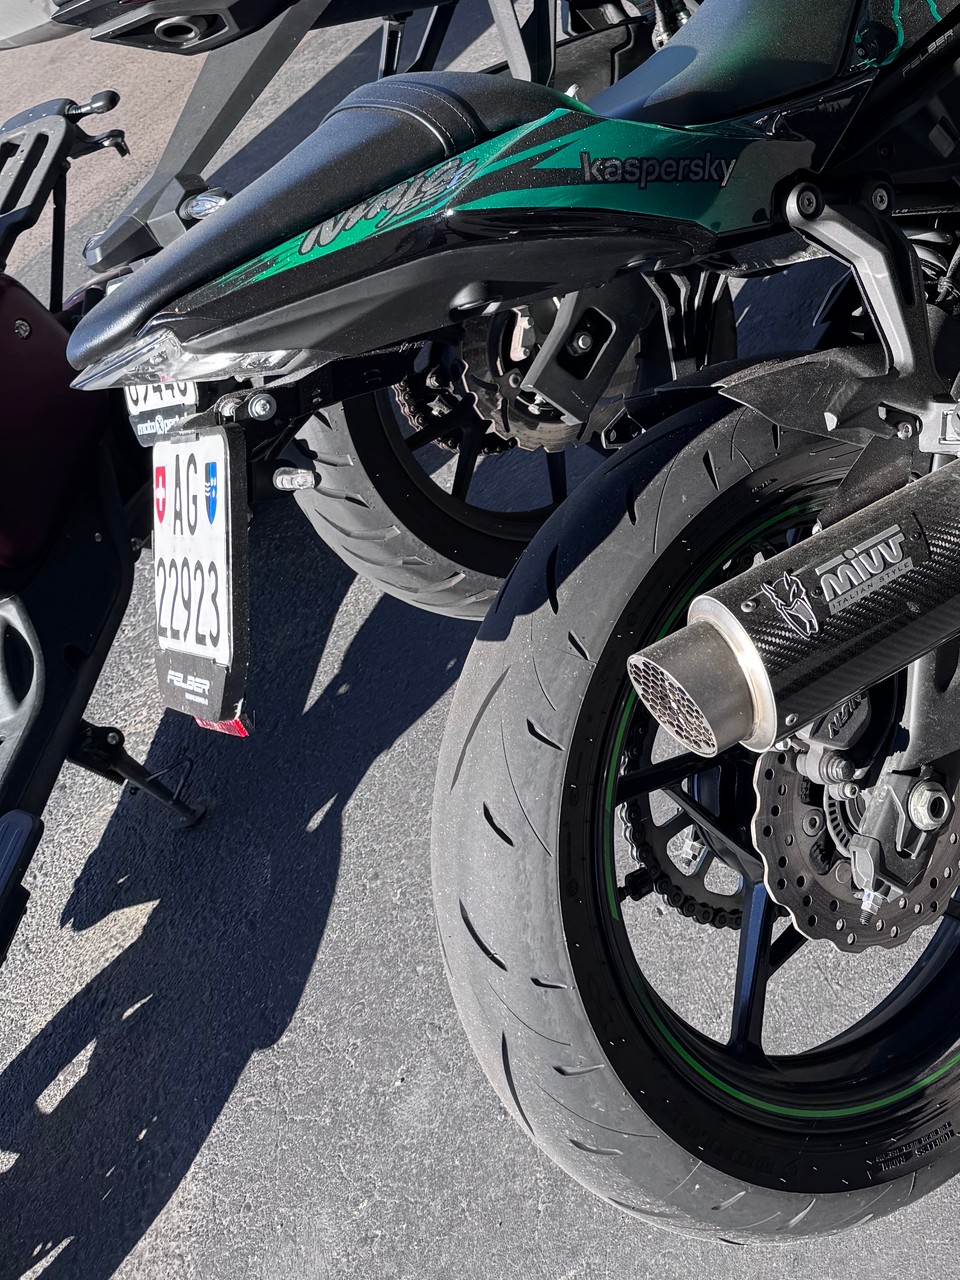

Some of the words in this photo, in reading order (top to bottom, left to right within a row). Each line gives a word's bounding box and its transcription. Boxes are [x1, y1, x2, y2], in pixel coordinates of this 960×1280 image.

[579, 151, 738, 189] kaspersky
[173, 453, 198, 536] AG
[156, 556, 220, 648] 22923
[832, 582, 874, 609] ITALIAN
[878, 561, 910, 583] STYLE
[167, 669, 210, 696] FELBER
